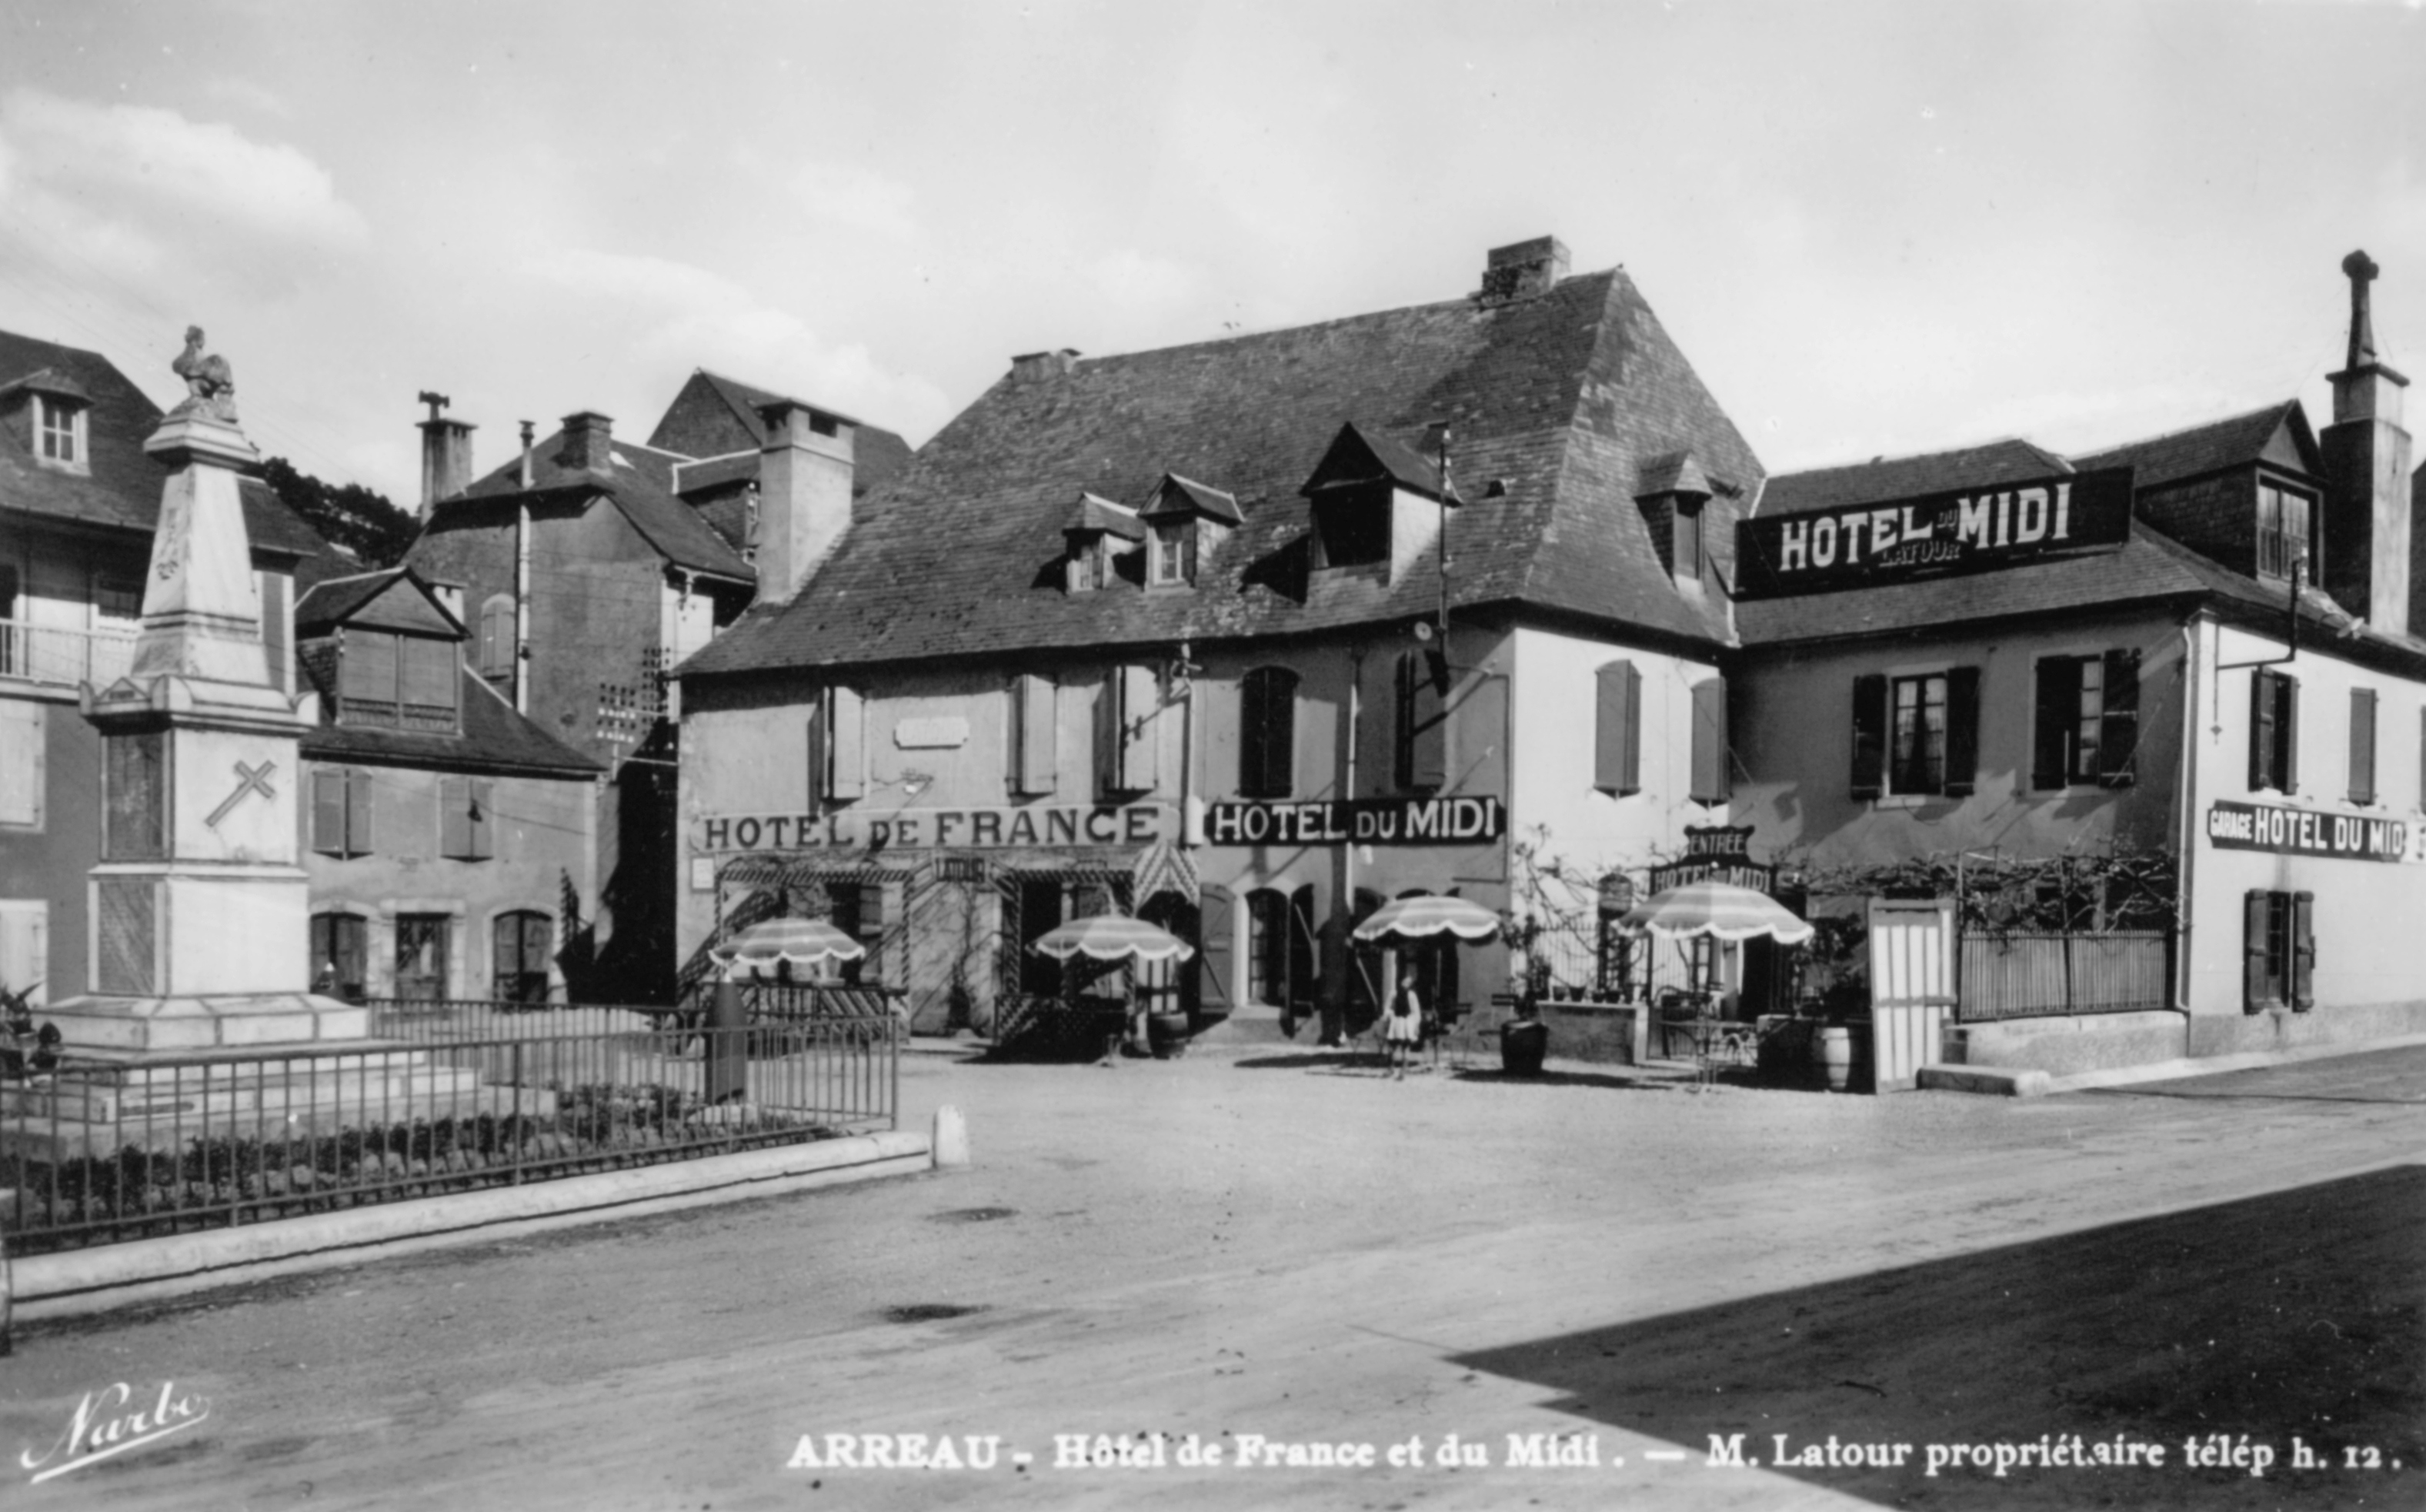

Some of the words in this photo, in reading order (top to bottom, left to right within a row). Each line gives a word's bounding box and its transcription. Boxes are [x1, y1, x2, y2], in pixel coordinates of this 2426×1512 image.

[1778, 506, 1934, 572] HOTEL
[1936, 509, 1959, 531] DU
[1955, 482, 2073, 549] MIDI
[1878, 540, 1961, 568] LATOUR
[705, 814, 854, 849] HOTEL
[870, 819, 919, 851] DE
[934, 807, 1159, 846] FRANCE
[1214, 803, 1346, 841] HOTEL
[1356, 810, 1397, 839] DU
[1404, 797, 1497, 839] MIDI
[2209, 810, 2254, 840] GARAGE
[2254, 807, 2328, 850] HOTEL
[2334, 816, 2363, 853] DU
[1730, 865, 1771, 894] MIDI
